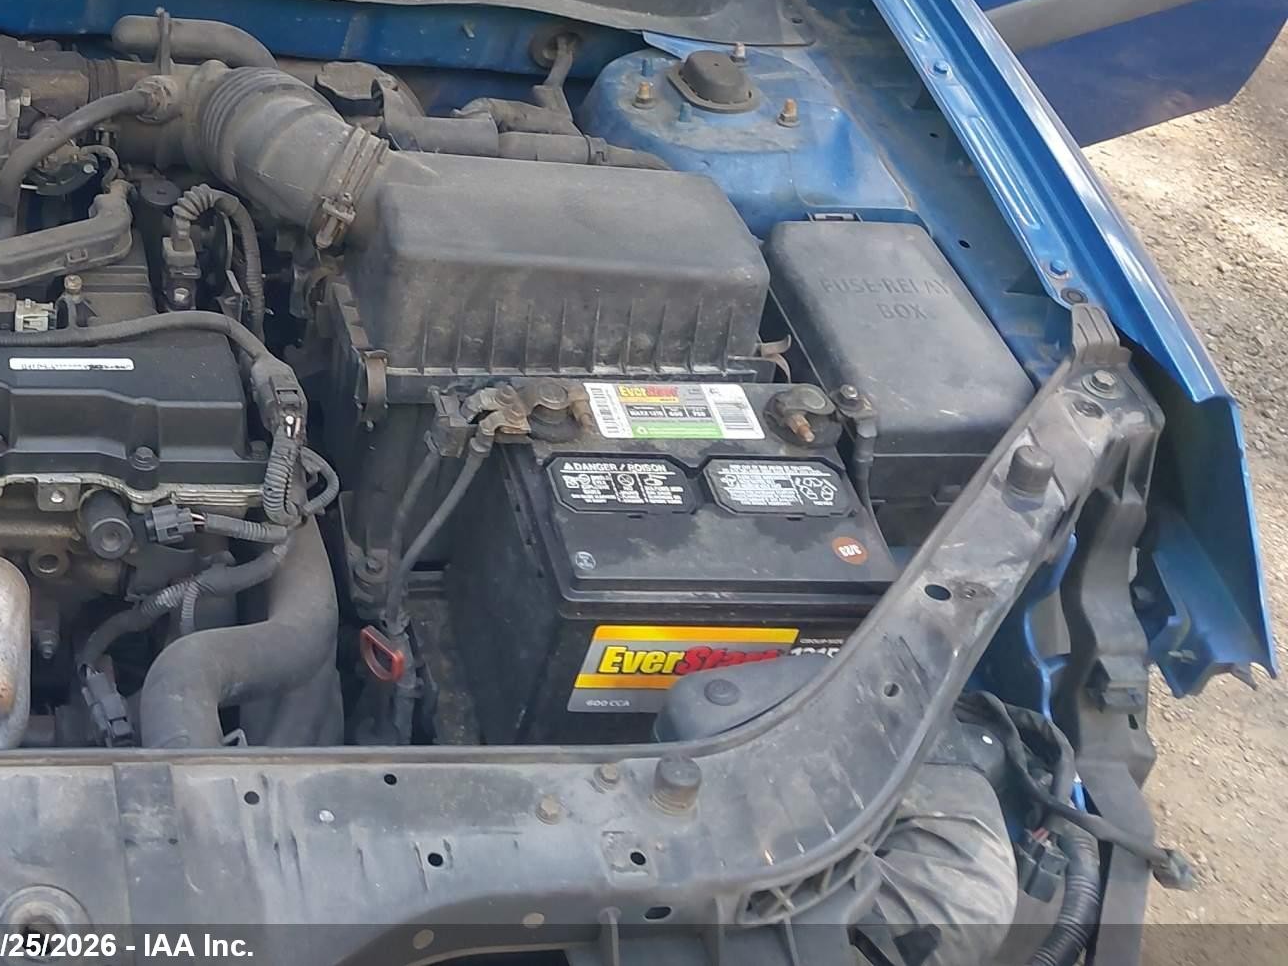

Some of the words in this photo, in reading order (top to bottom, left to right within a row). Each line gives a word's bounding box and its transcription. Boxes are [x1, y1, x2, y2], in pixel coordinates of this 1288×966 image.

[877, 303, 928, 321] BOX
[573, 463, 617, 471] DANGER
[627, 464, 667, 472] POISON
